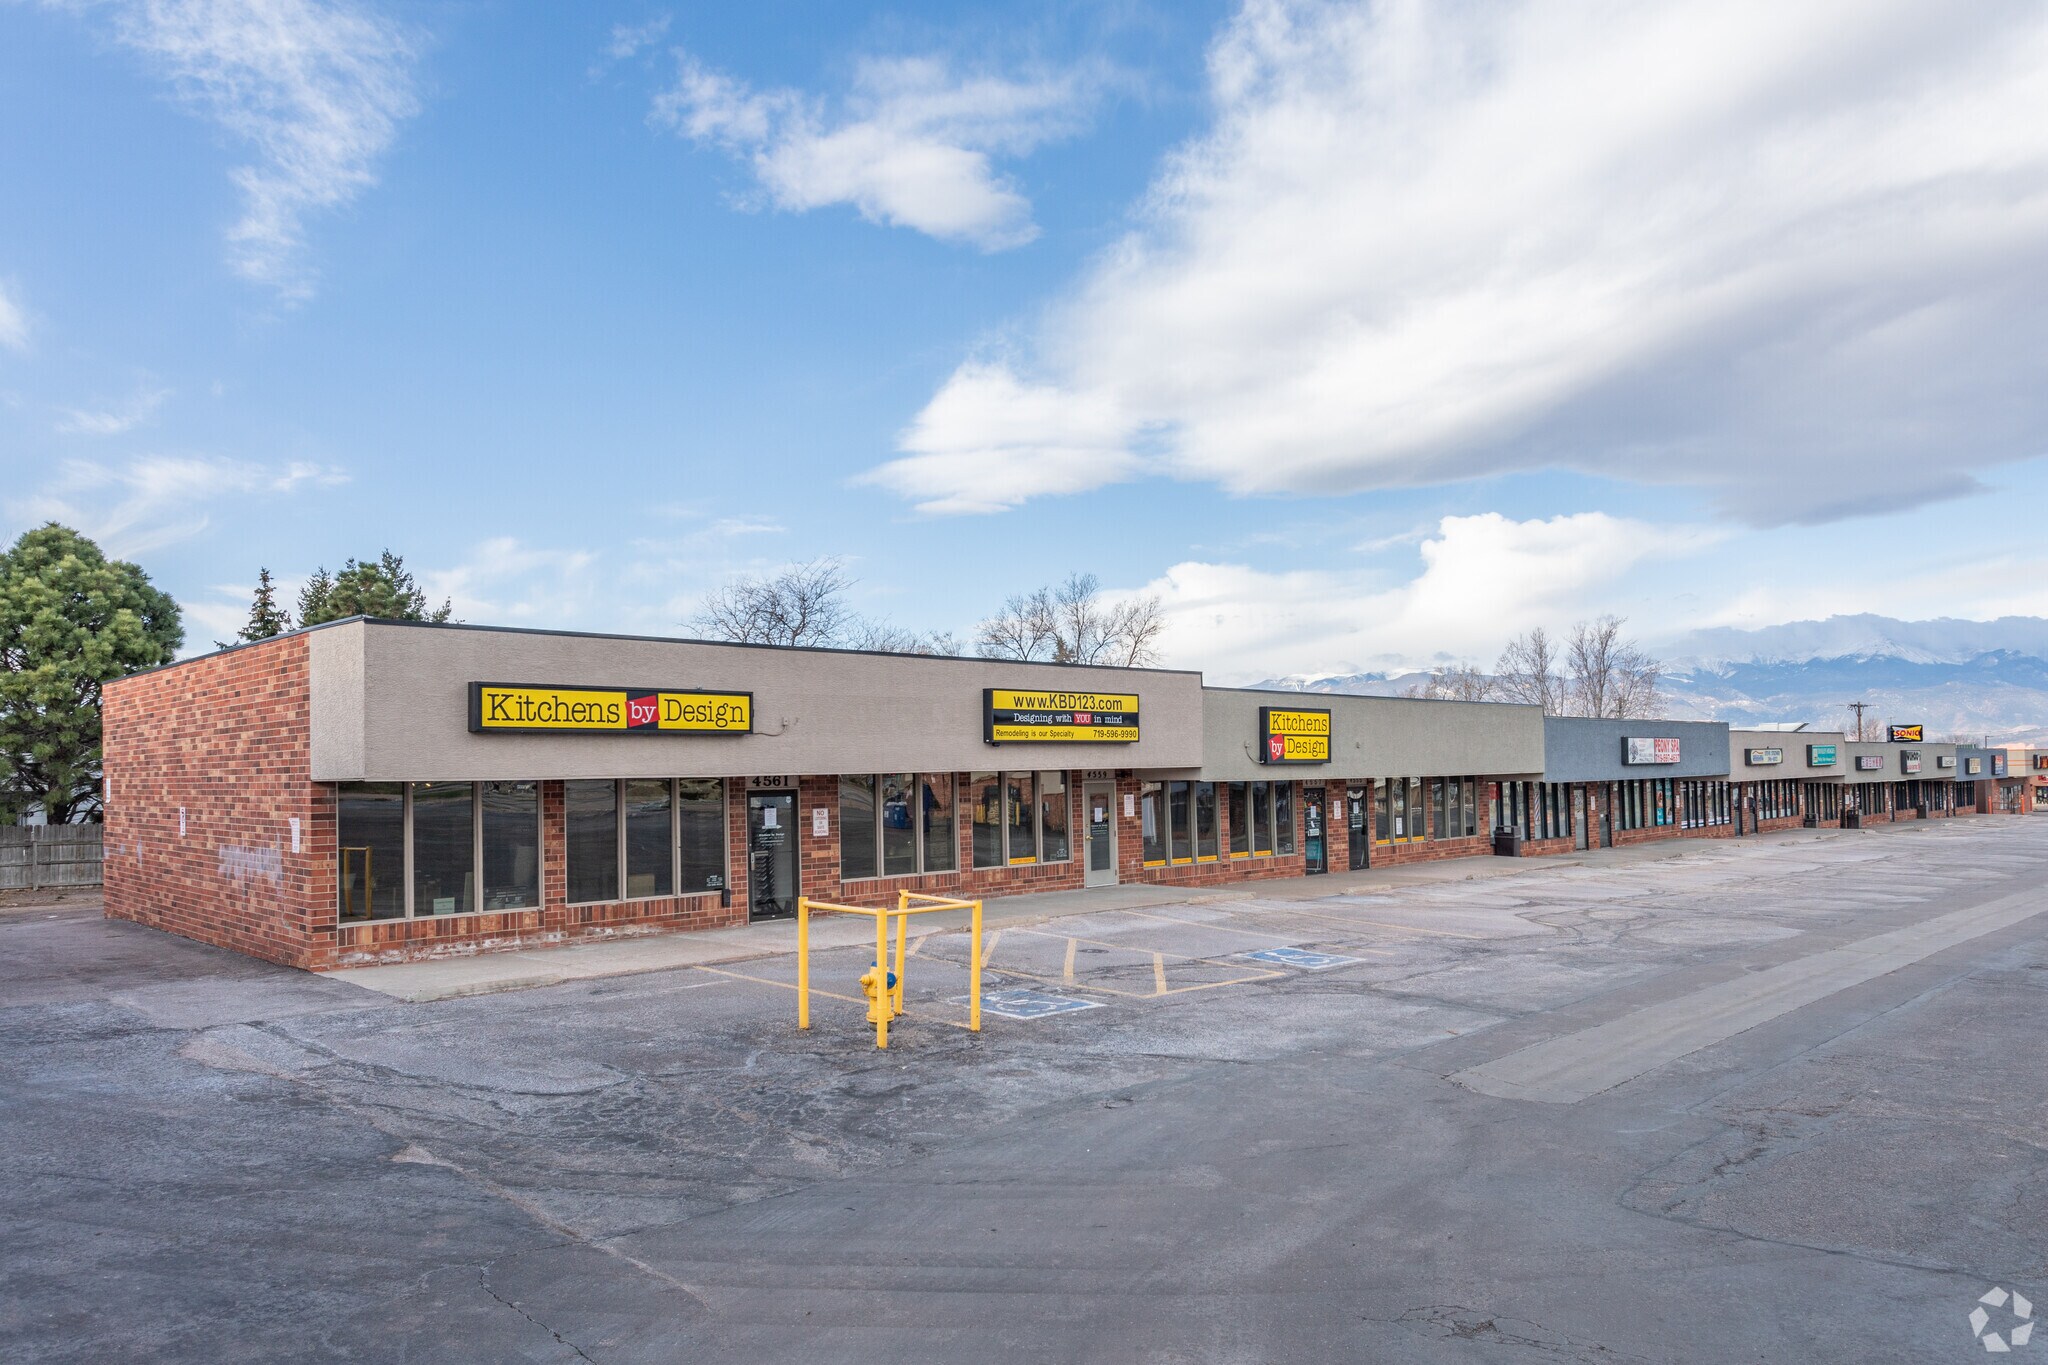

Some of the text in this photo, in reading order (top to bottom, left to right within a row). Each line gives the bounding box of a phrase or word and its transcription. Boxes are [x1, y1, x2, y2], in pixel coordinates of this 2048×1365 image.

[1013, 693, 1123, 711] www.KBD123.com
[487, 693, 745, 728] Kitchens by Design
[1013, 712, 1123, 724] Designing with YOU in mind
[1271, 713, 1328, 732] Kitchens
[995, 729, 1029, 738] Remodeling
[1049, 730, 1075, 738] Specialty
[1093, 729, 1137, 738] 719-596-9990
[1894, 729, 1920, 737] SONIC
[1271, 738, 1326, 757] by Design
[1654, 738, 1670, 753] PEONY
[1670, 738, 1680, 753] SPA
[752, 775, 789, 786] 4561
[1087, 770, 1107, 779] 4559
